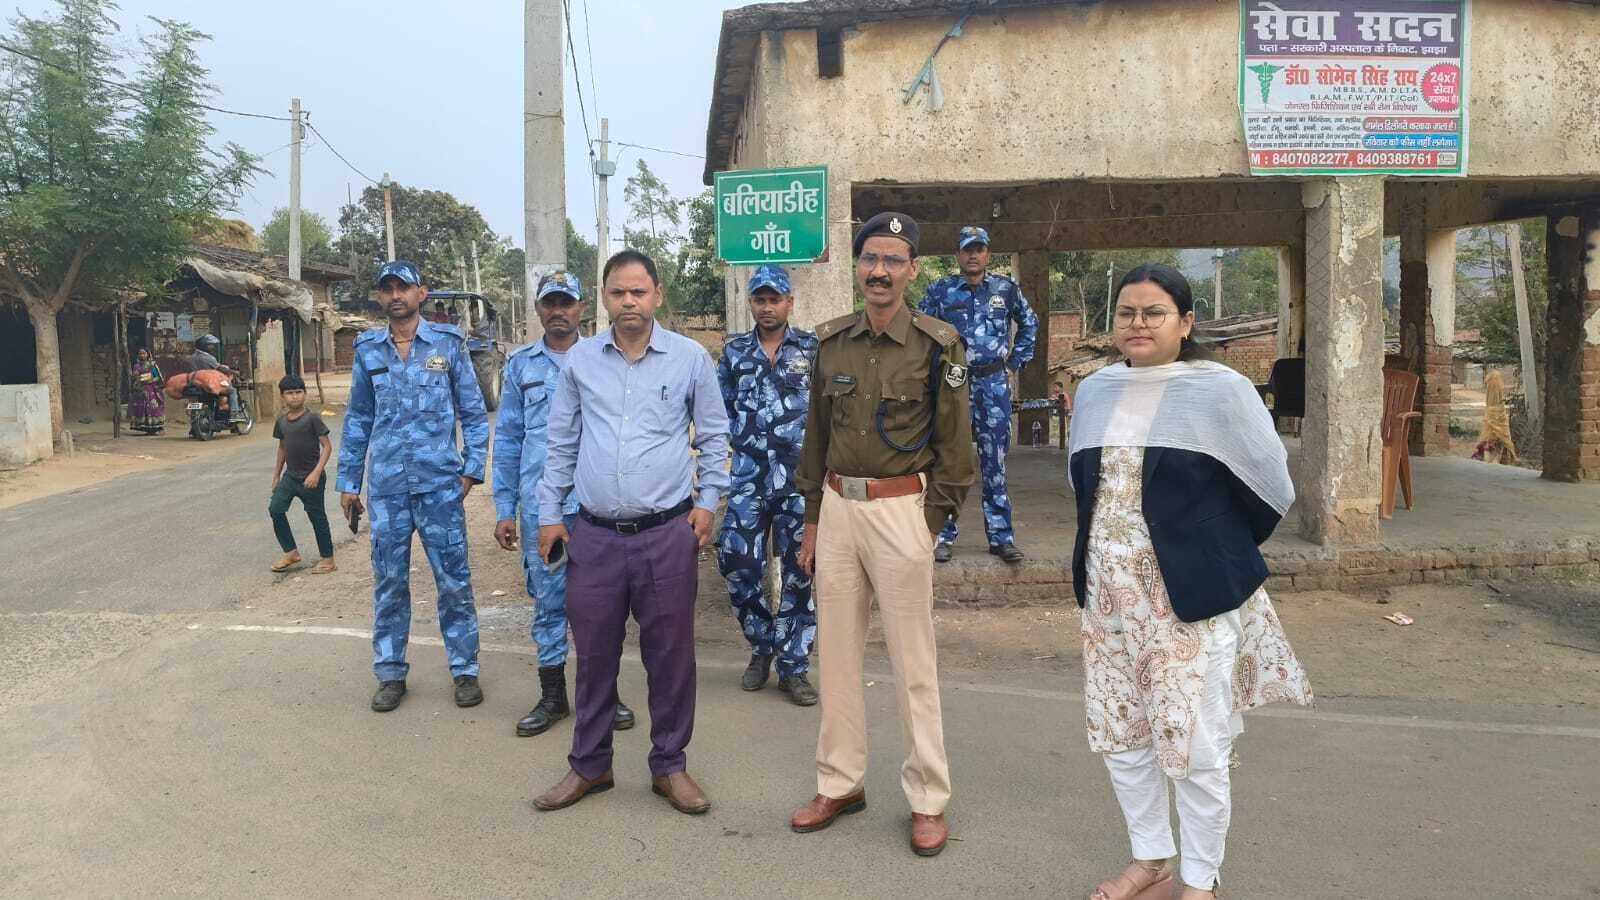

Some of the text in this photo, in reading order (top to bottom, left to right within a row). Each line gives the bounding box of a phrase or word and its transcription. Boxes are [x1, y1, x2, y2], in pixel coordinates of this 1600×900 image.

[1250, 2, 1457, 42] सेवा सदन
[1259, 44, 1278, 52] पता
[1291, 42, 1327, 53] सरकारी
[1329, 44, 1372, 53] अस्पताल
[1374, 43, 1385, 53] के
[1316, 64, 1357, 85] सोमेन
[1361, 64, 1389, 86] सिंह
[1394, 69, 1418, 86] राय
[1430, 71, 1457, 83] 24x7
[1356, 152, 1432, 165] 8409388761
[723, 181, 819, 216] बलियाडीह
[750, 221, 791, 254] गाँव
